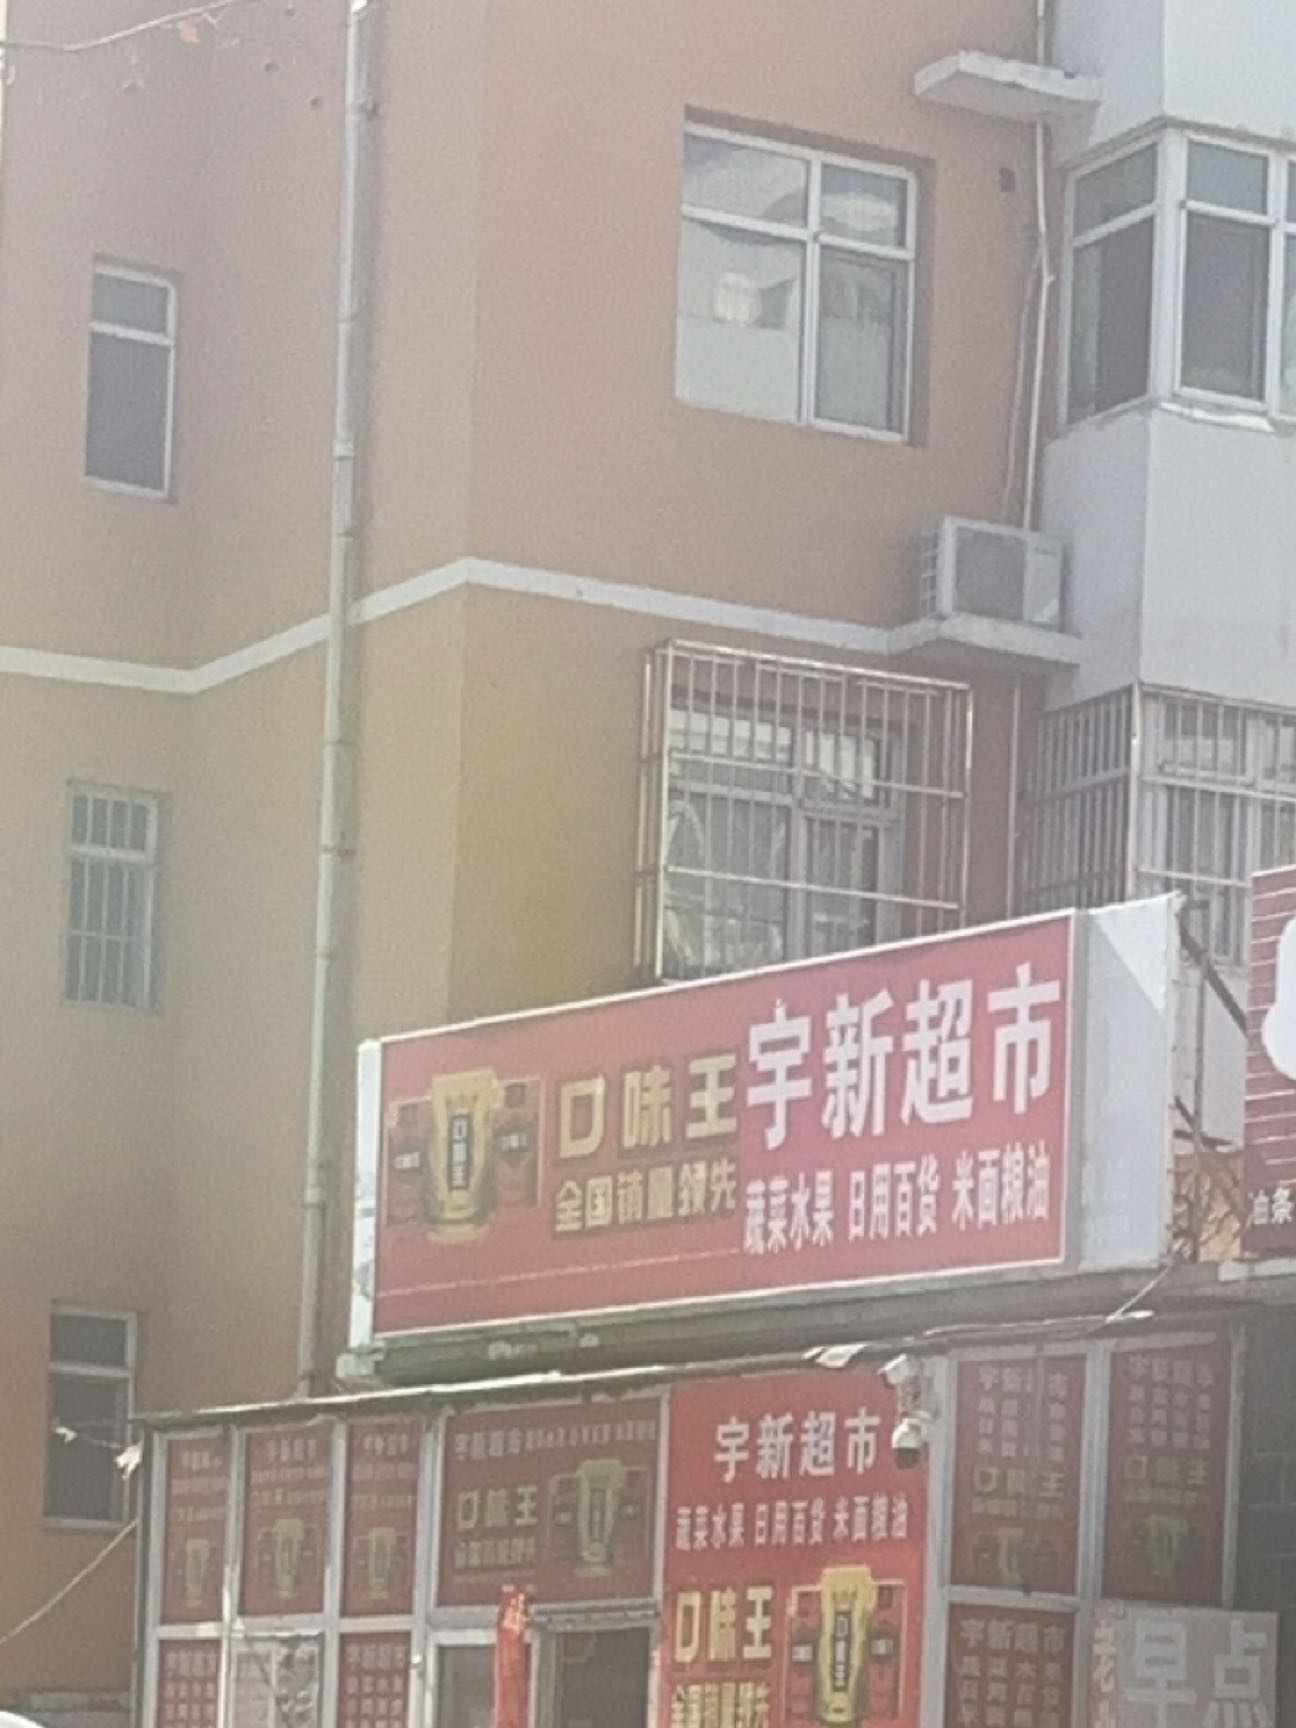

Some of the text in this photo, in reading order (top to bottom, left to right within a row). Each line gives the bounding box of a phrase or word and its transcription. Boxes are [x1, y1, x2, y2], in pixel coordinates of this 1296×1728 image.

[558, 1054, 737, 1159] 口味王
[747, 962, 1061, 1151] 宇新超市
[744, 1139, 1052, 1255] 蔬菜水果 日用百货 米面粮油
[713, 1406, 880, 1484] 宇新超市
